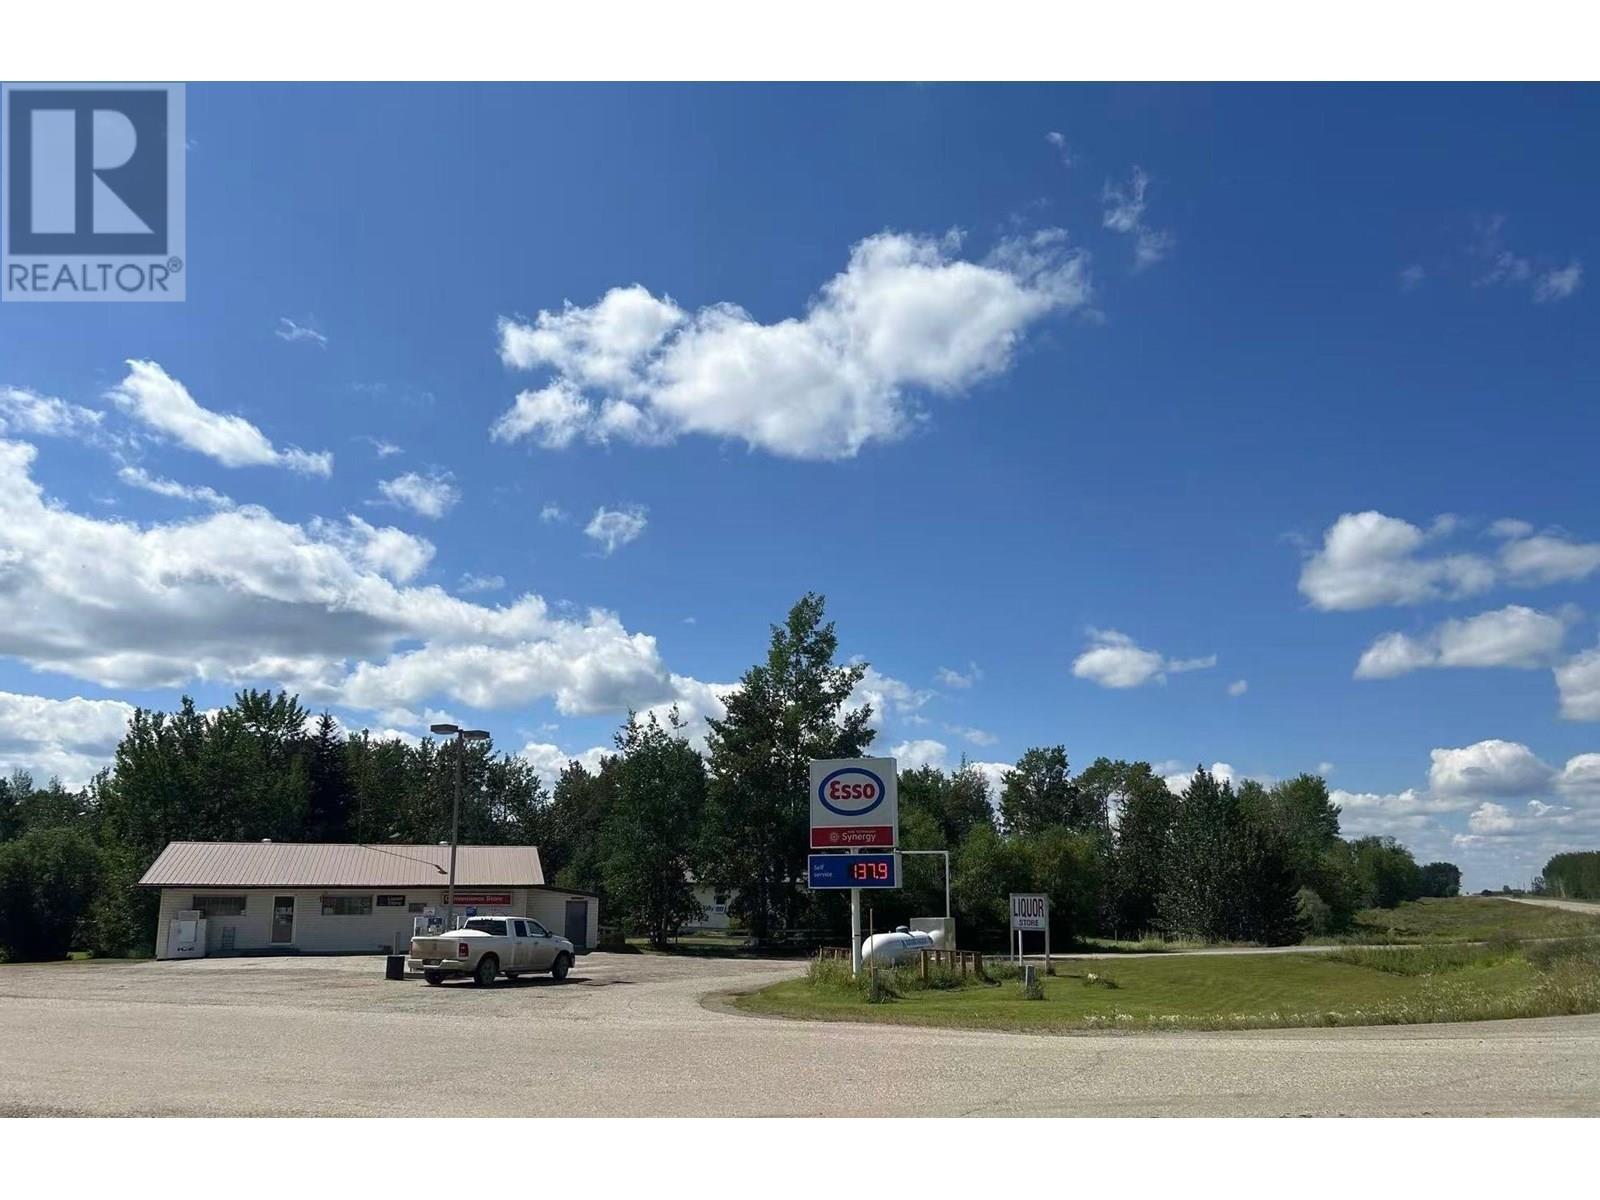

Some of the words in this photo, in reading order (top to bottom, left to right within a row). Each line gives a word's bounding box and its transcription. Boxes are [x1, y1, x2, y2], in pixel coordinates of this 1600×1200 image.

[842, 832, 876, 843] Synergy
[853, 863, 888, 880] 137.9
[1013, 898, 1044, 917] LIQUOR
[1018, 919, 1040, 927] STORE
